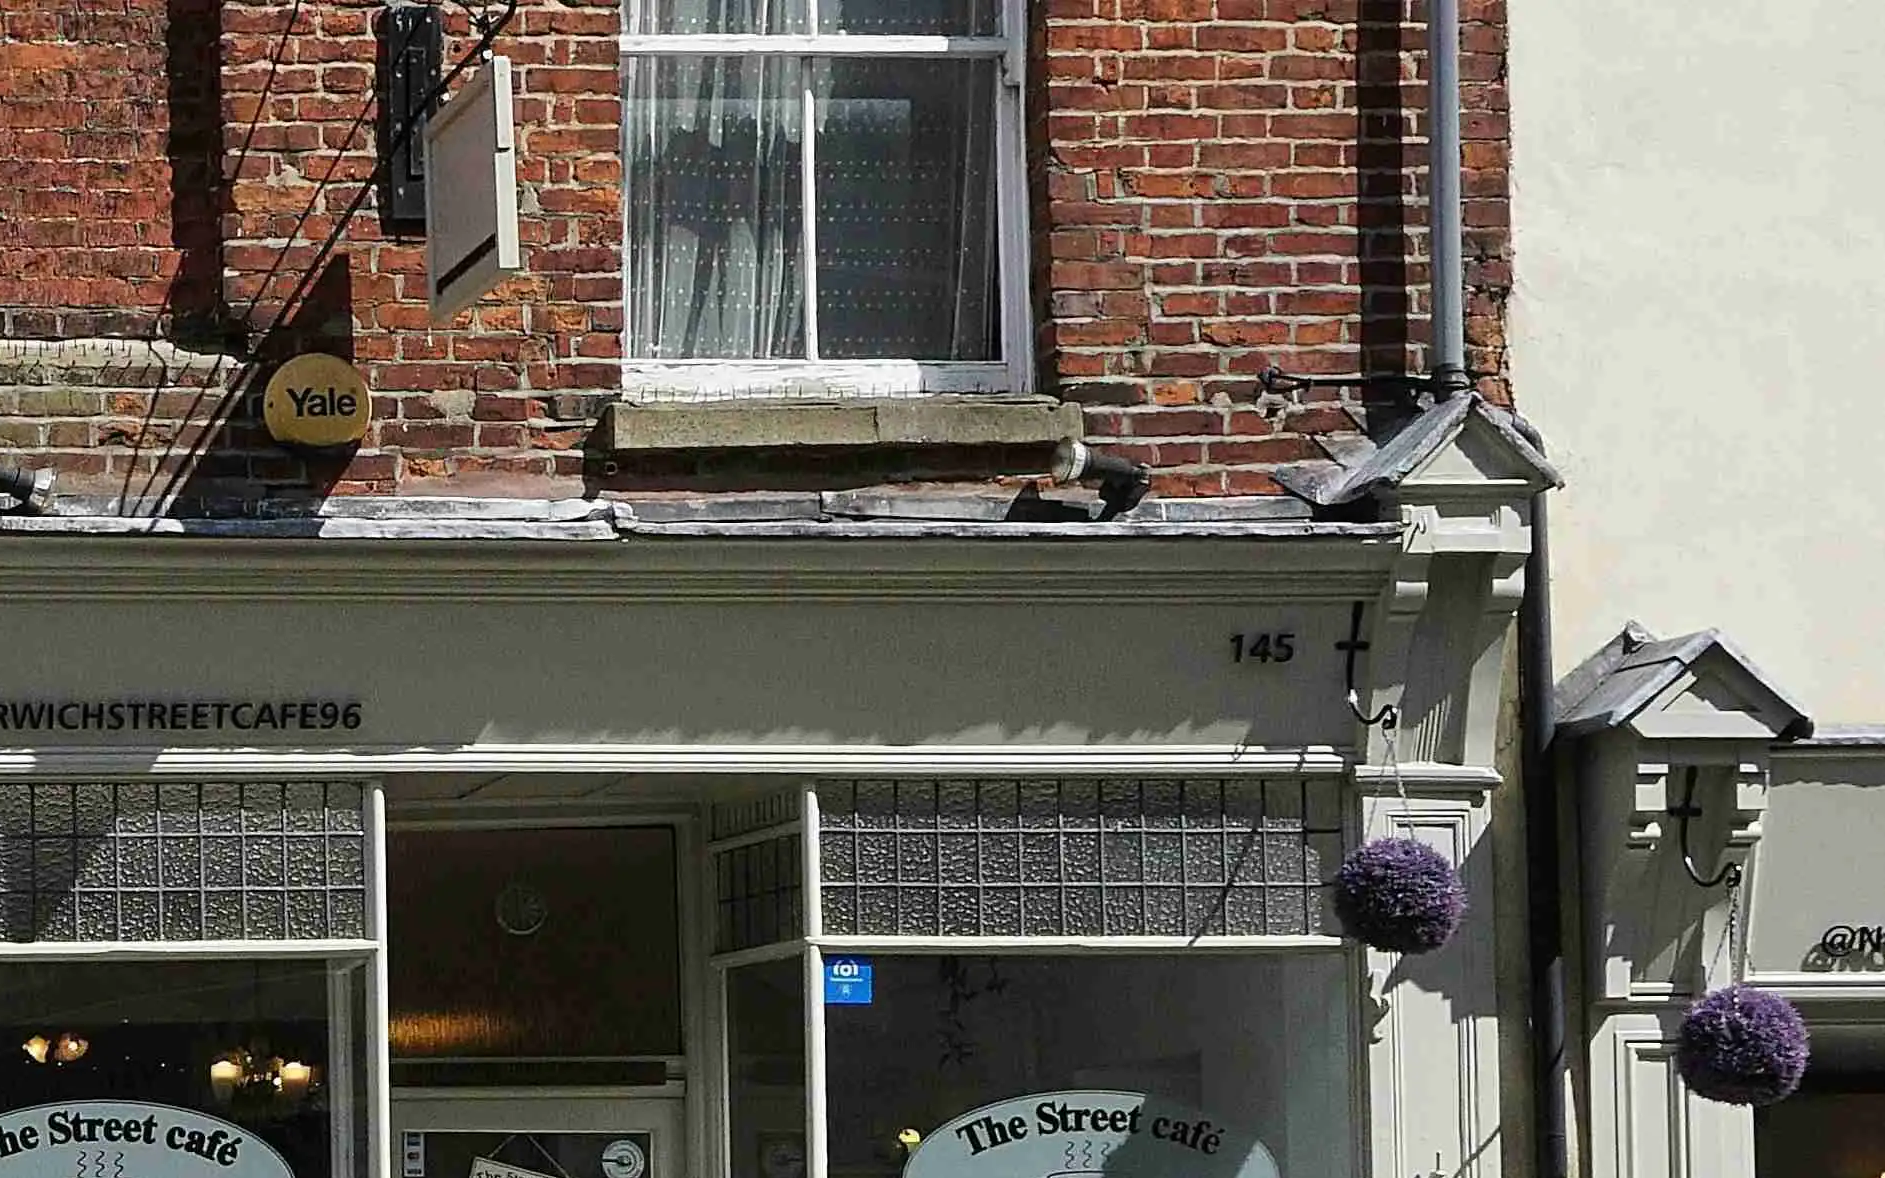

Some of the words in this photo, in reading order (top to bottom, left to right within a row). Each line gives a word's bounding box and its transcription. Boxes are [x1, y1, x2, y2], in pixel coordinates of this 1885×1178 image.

[285, 387, 357, 418] Yale
[1229, 633, 1296, 664] 145
[48, 1110, 158, 1146] Street
[166, 1125, 243, 1167] café
[956, 1115, 1028, 1156] The
[1036, 1100, 1142, 1136] Street
[1151, 1115, 1225, 1155] café
